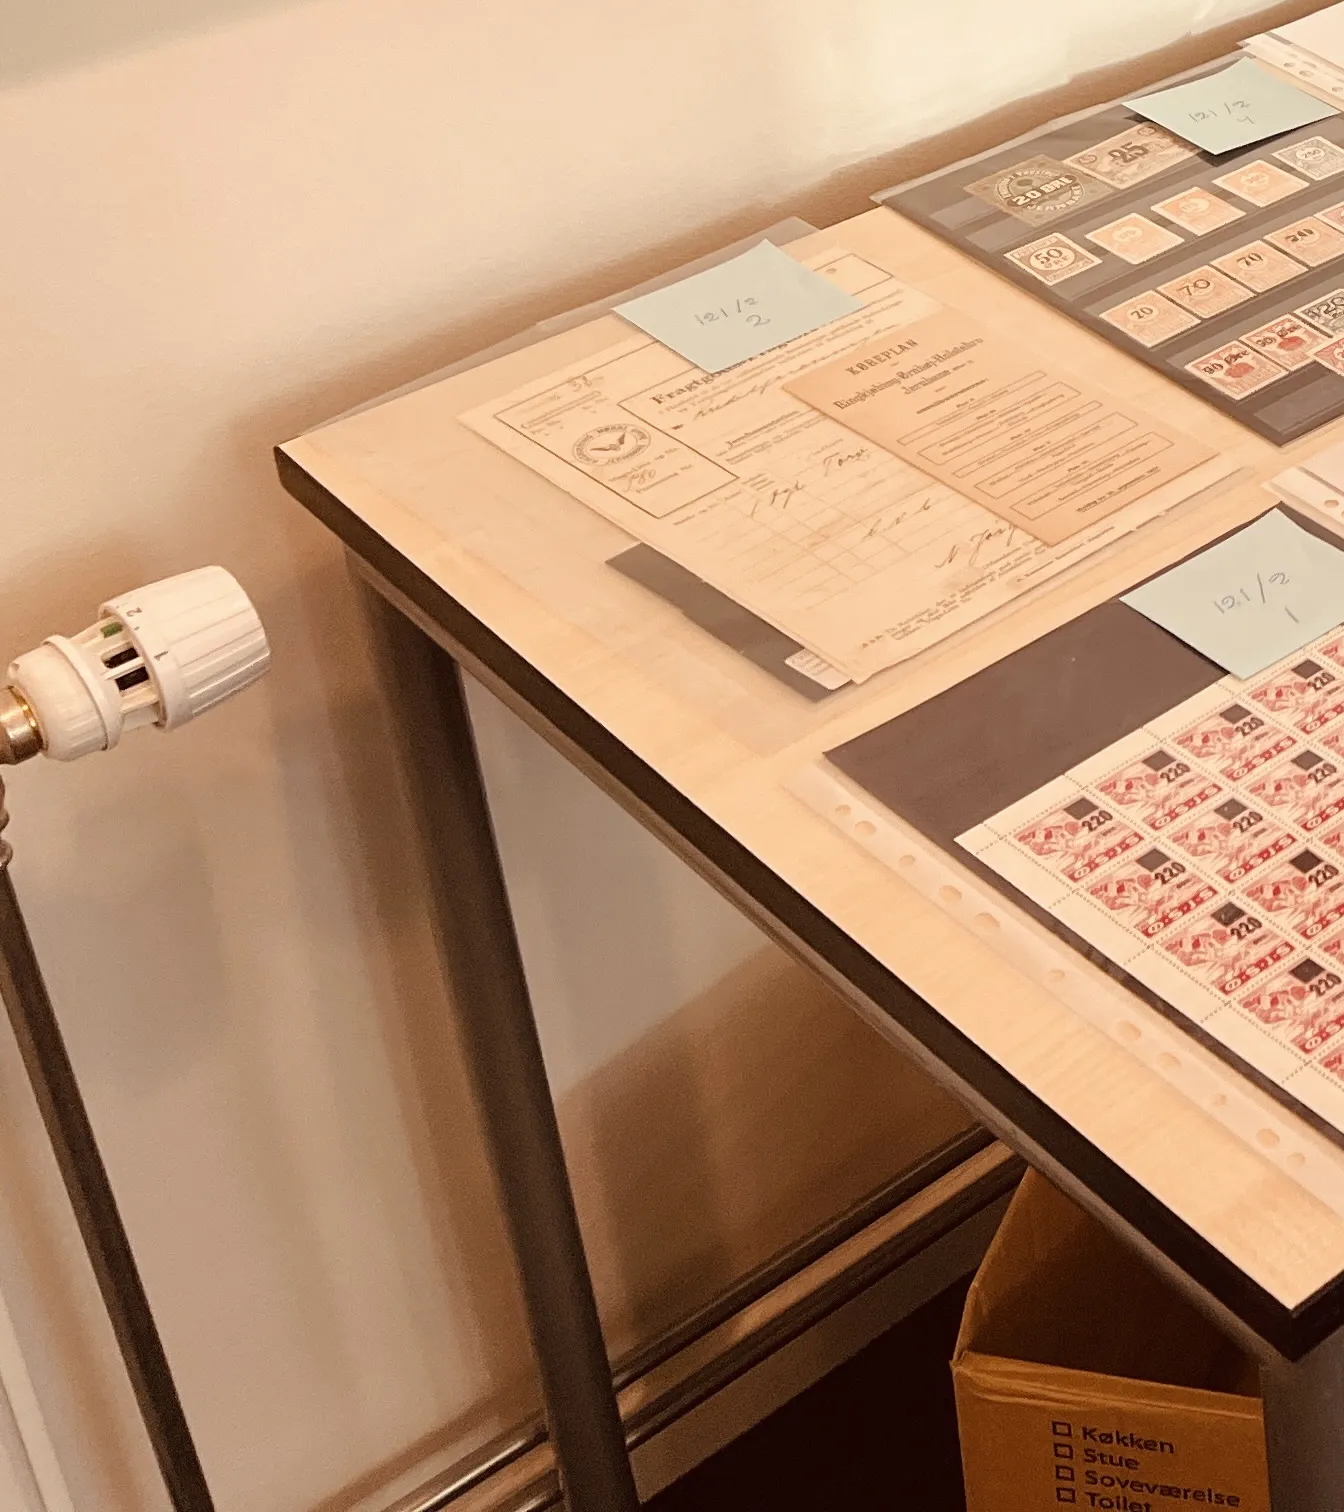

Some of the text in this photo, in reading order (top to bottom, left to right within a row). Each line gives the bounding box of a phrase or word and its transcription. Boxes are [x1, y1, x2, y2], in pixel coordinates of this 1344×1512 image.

[1107, 141, 1149, 164] 25
[1012, 189, 1042, 207] 20
[1035, 248, 1063, 266] 50
[1236, 252, 1265, 267] 70
[1176, 278, 1211, 297] 70
[745, 314, 772, 330] 2
[845, 339, 919, 376] KØREPLAN
[1308, 672, 1336, 691] 220
[1236, 717, 1265, 737] 220
[1161, 762, 1190, 783] 220
[1308, 763, 1337, 784] 220
[1082, 810, 1112, 832] 220
[1233, 811, 1262, 833] 220
[1155, 861, 1185, 884] 220
[1308, 863, 1339, 887] 220
[1230, 916, 1261, 940] 220
[1310, 972, 1340, 997] 220
[1081, 1426, 1175, 1454] Køkken
[1083, 1447, 1141, 1470] Stue
[1084, 1470, 1241, 1508] Soveværelse
